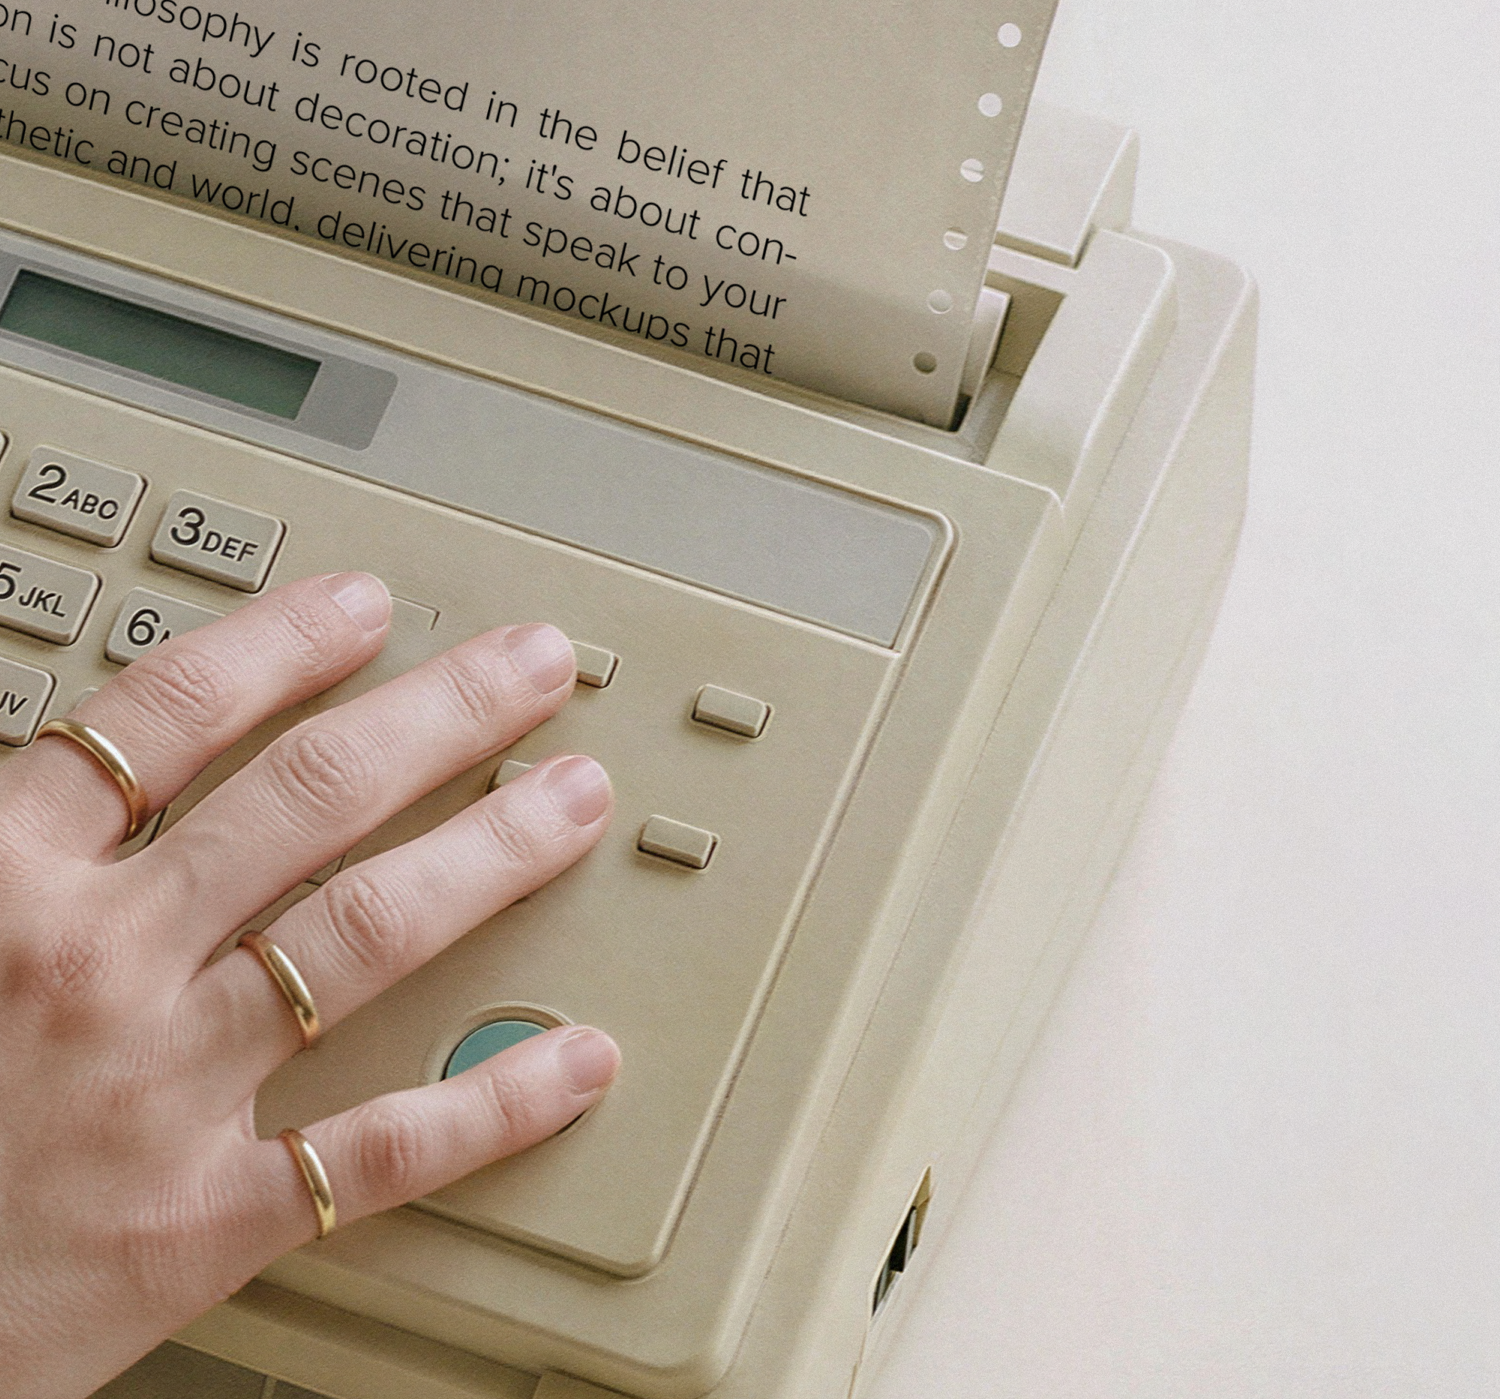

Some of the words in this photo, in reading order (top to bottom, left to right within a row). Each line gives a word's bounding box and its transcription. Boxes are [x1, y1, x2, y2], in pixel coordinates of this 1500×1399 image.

[47, 12, 78, 50] is
[93, 34, 155, 75] not
[168, 56, 280, 113] about
[294, 92, 510, 187] decoration;
[525, 158, 575, 201] it's
[589, 184, 701, 241] about
[715, 224, 797, 265] con-
[65, 81, 111, 116] on
[125, 100, 277, 173] creating
[289, 150, 427, 211] scenes
[440, 190, 513, 239] that
[522, 221, 641, 277] speak
[653, 254, 689, 291] to
[699, 274, 787, 320] your
[290, 31, 323, 68] is
[339, 53, 470, 113] rooted
[484, 89, 518, 128] in
[538, 107, 598, 151] the
[616, 129, 729, 189] belief
[740, 168, 811, 218] that
[106, 149, 178, 191] and
[516, 274, 691, 348] mockups
[704, 325, 776, 375] that
